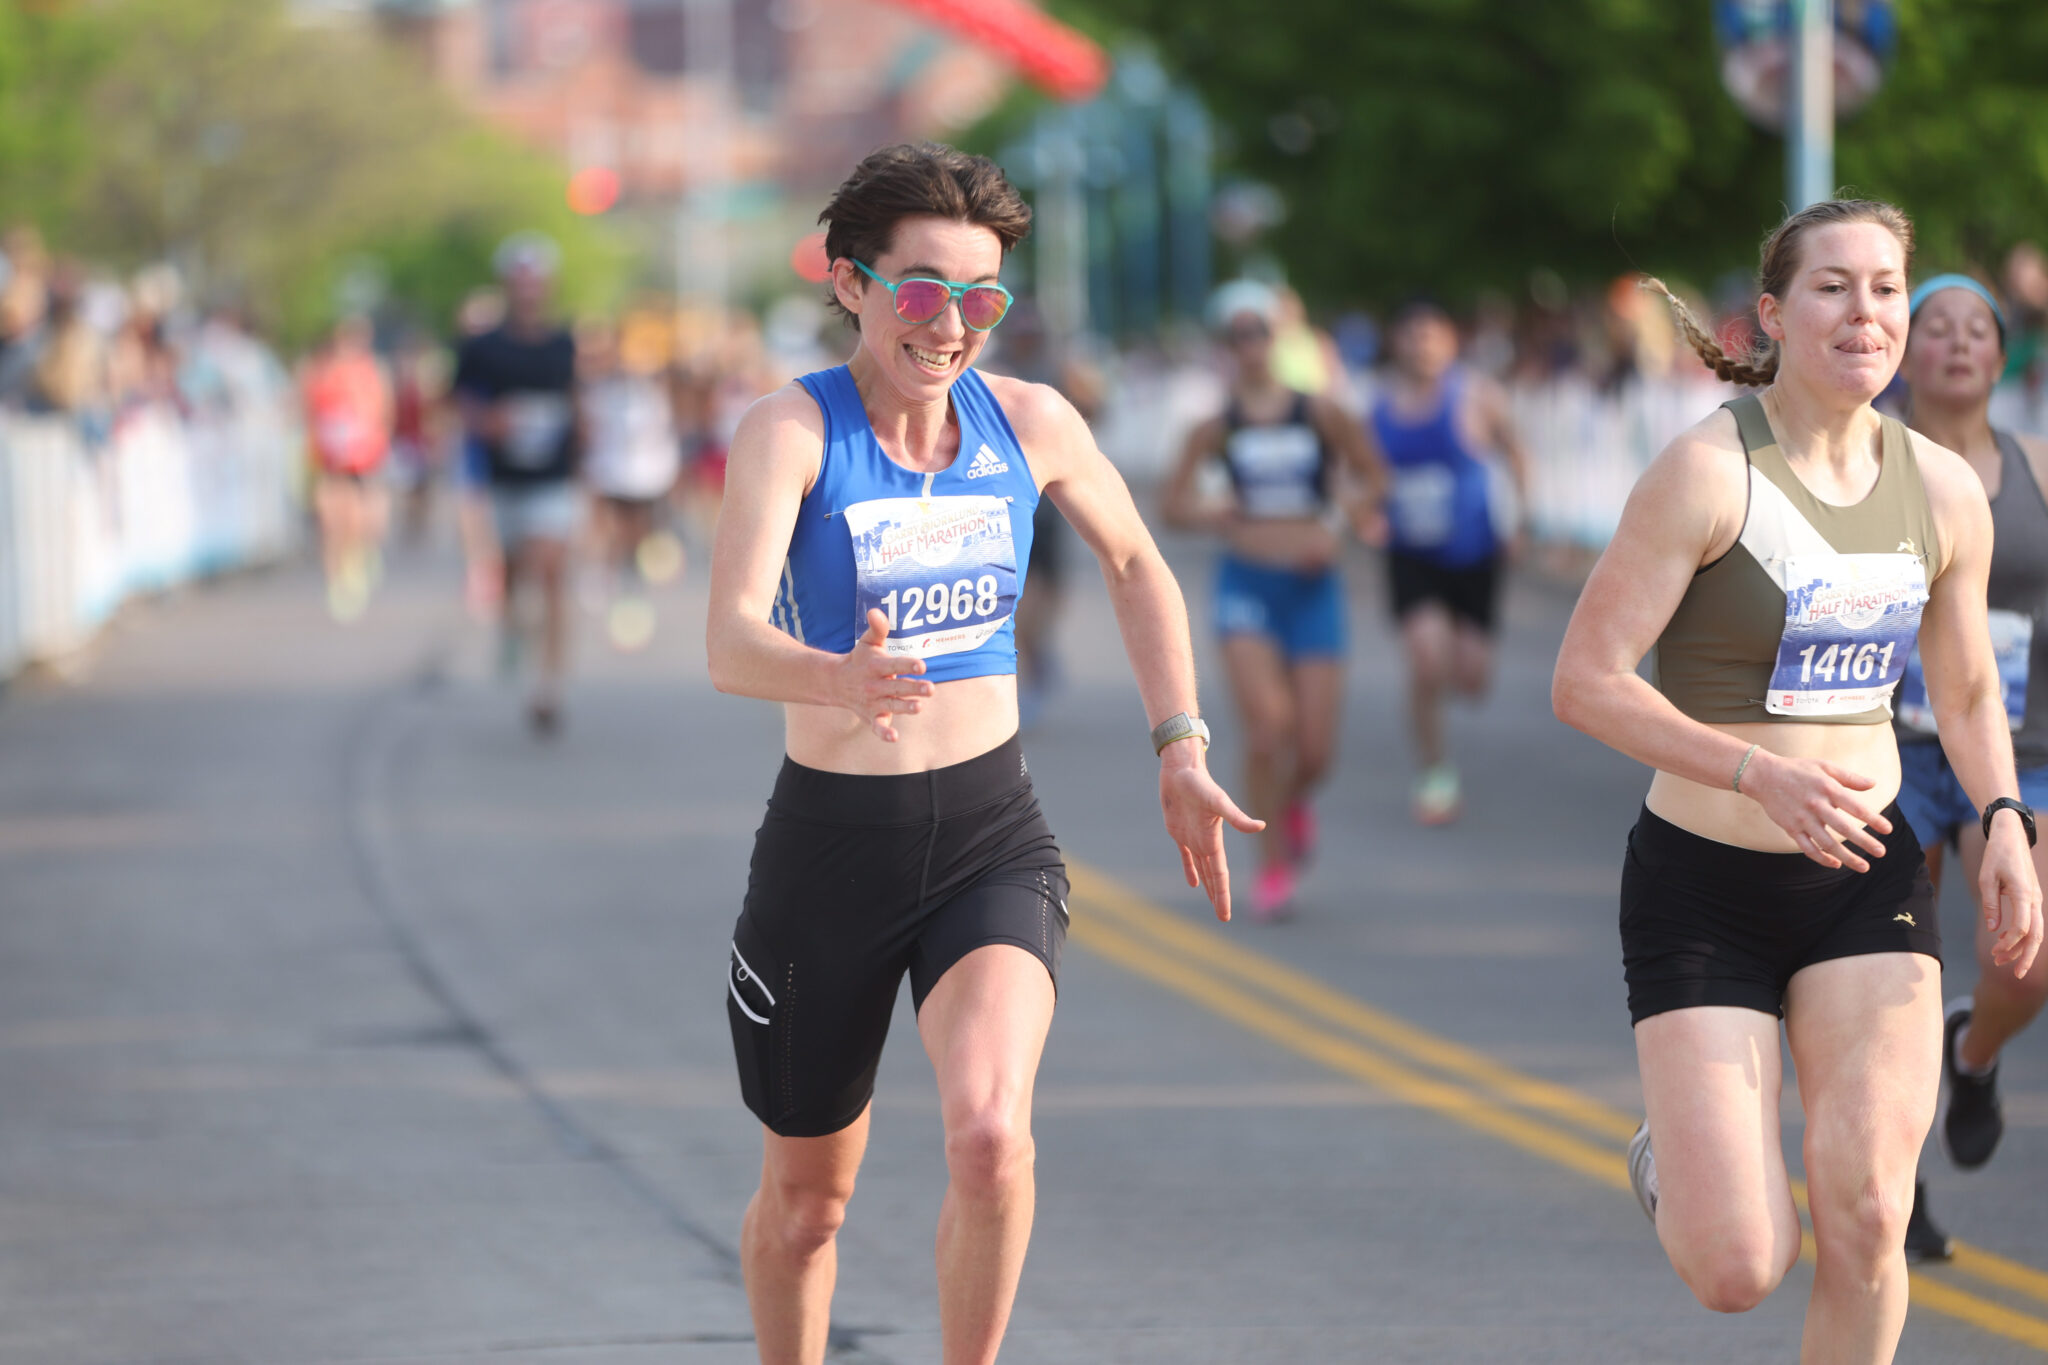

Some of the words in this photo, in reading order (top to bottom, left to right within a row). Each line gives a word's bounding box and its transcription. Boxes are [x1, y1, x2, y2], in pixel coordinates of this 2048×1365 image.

[967, 461, 1008, 480] adidas
[881, 539, 914, 565] HALF
[916, 516, 986, 551] MARATHON
[881, 574, 998, 631] 12968
[1808, 600, 1842, 622] HALF
[1842, 588, 1908, 614] MARATHON
[1799, 641, 1896, 683] 14161
